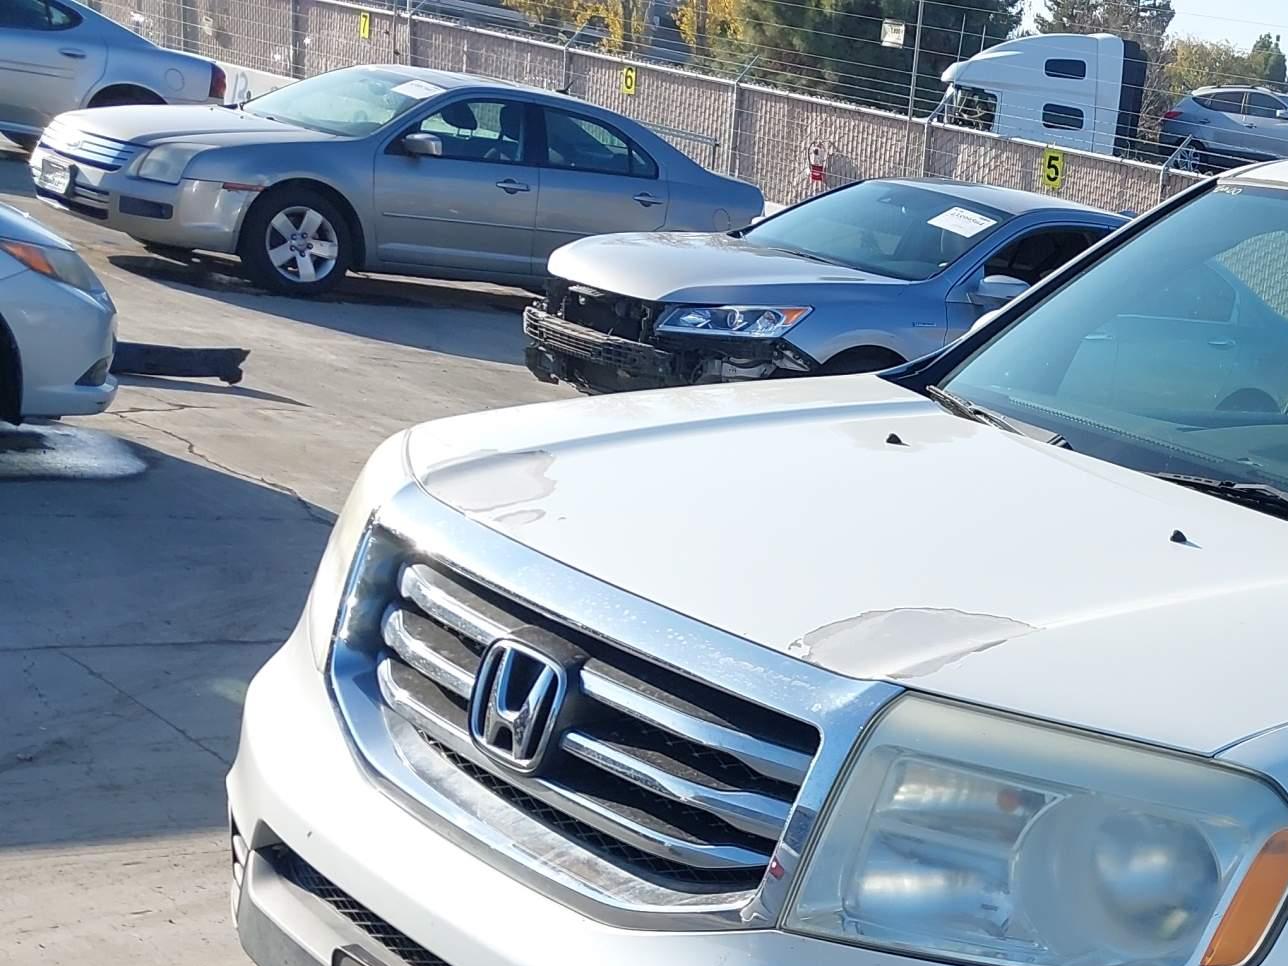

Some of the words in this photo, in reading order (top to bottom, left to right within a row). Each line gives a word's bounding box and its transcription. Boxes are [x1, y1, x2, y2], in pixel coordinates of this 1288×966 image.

[362, 14, 368, 33] 7
[625, 67, 634, 89] 6
[1047, 155, 1059, 181] 5
